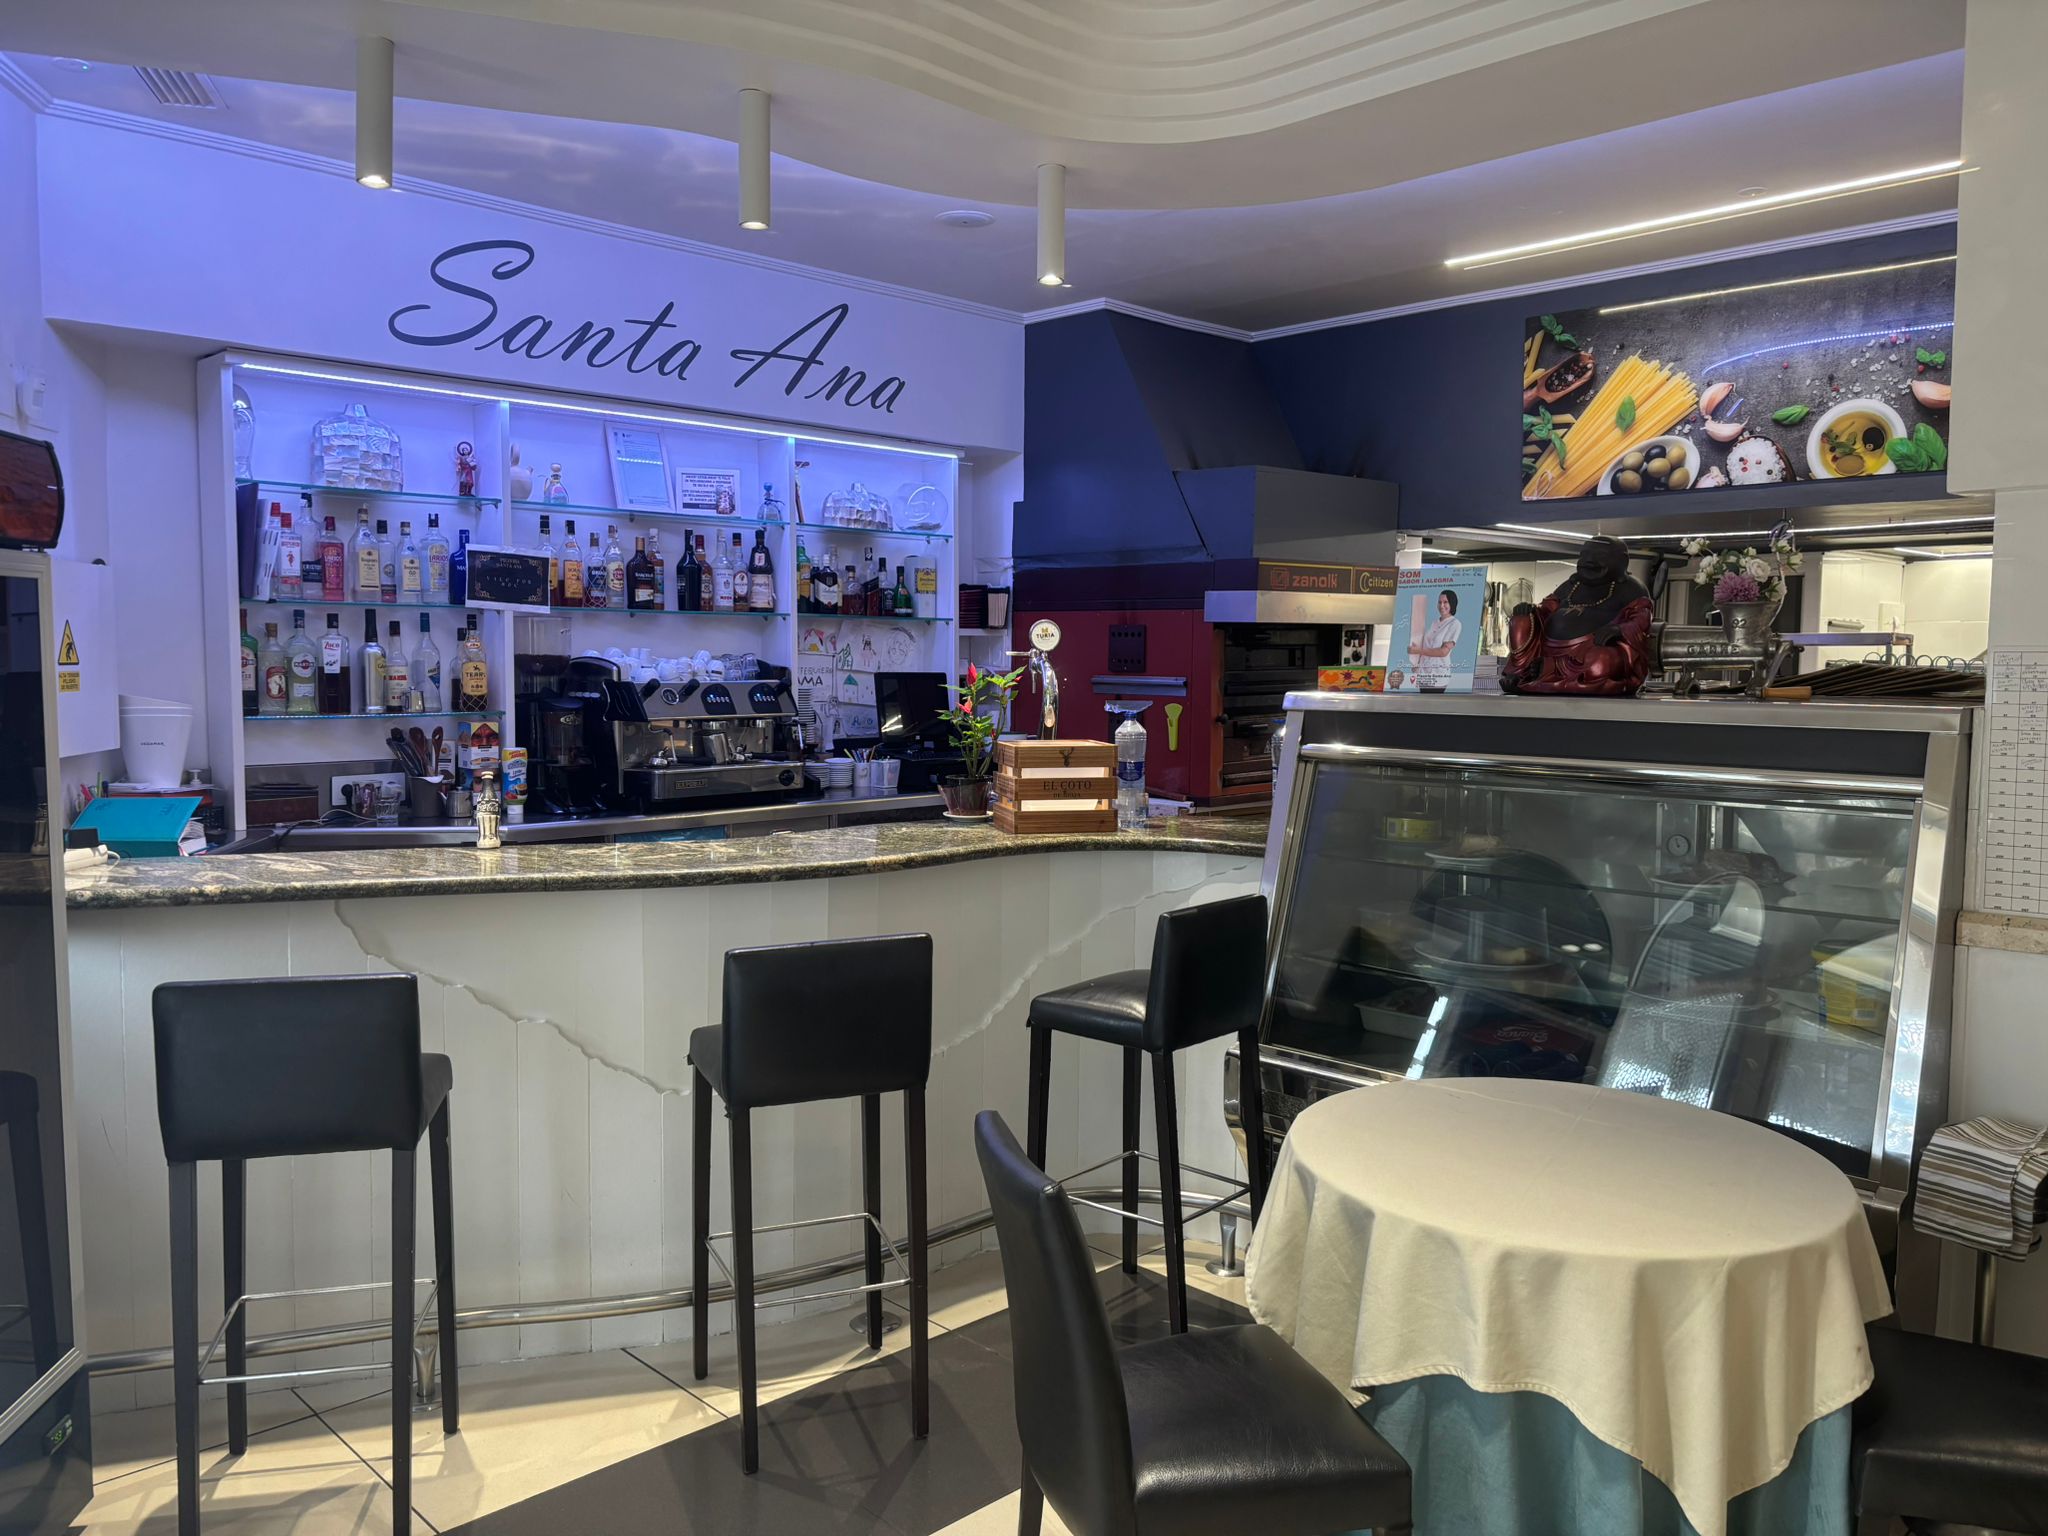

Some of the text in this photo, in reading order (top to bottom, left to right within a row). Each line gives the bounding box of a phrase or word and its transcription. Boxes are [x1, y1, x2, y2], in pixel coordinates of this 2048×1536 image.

[388, 239, 907, 414] Santa Ana
[1399, 570, 1422, 579] SOM
[1043, 780, 1092, 791] EL COTO
